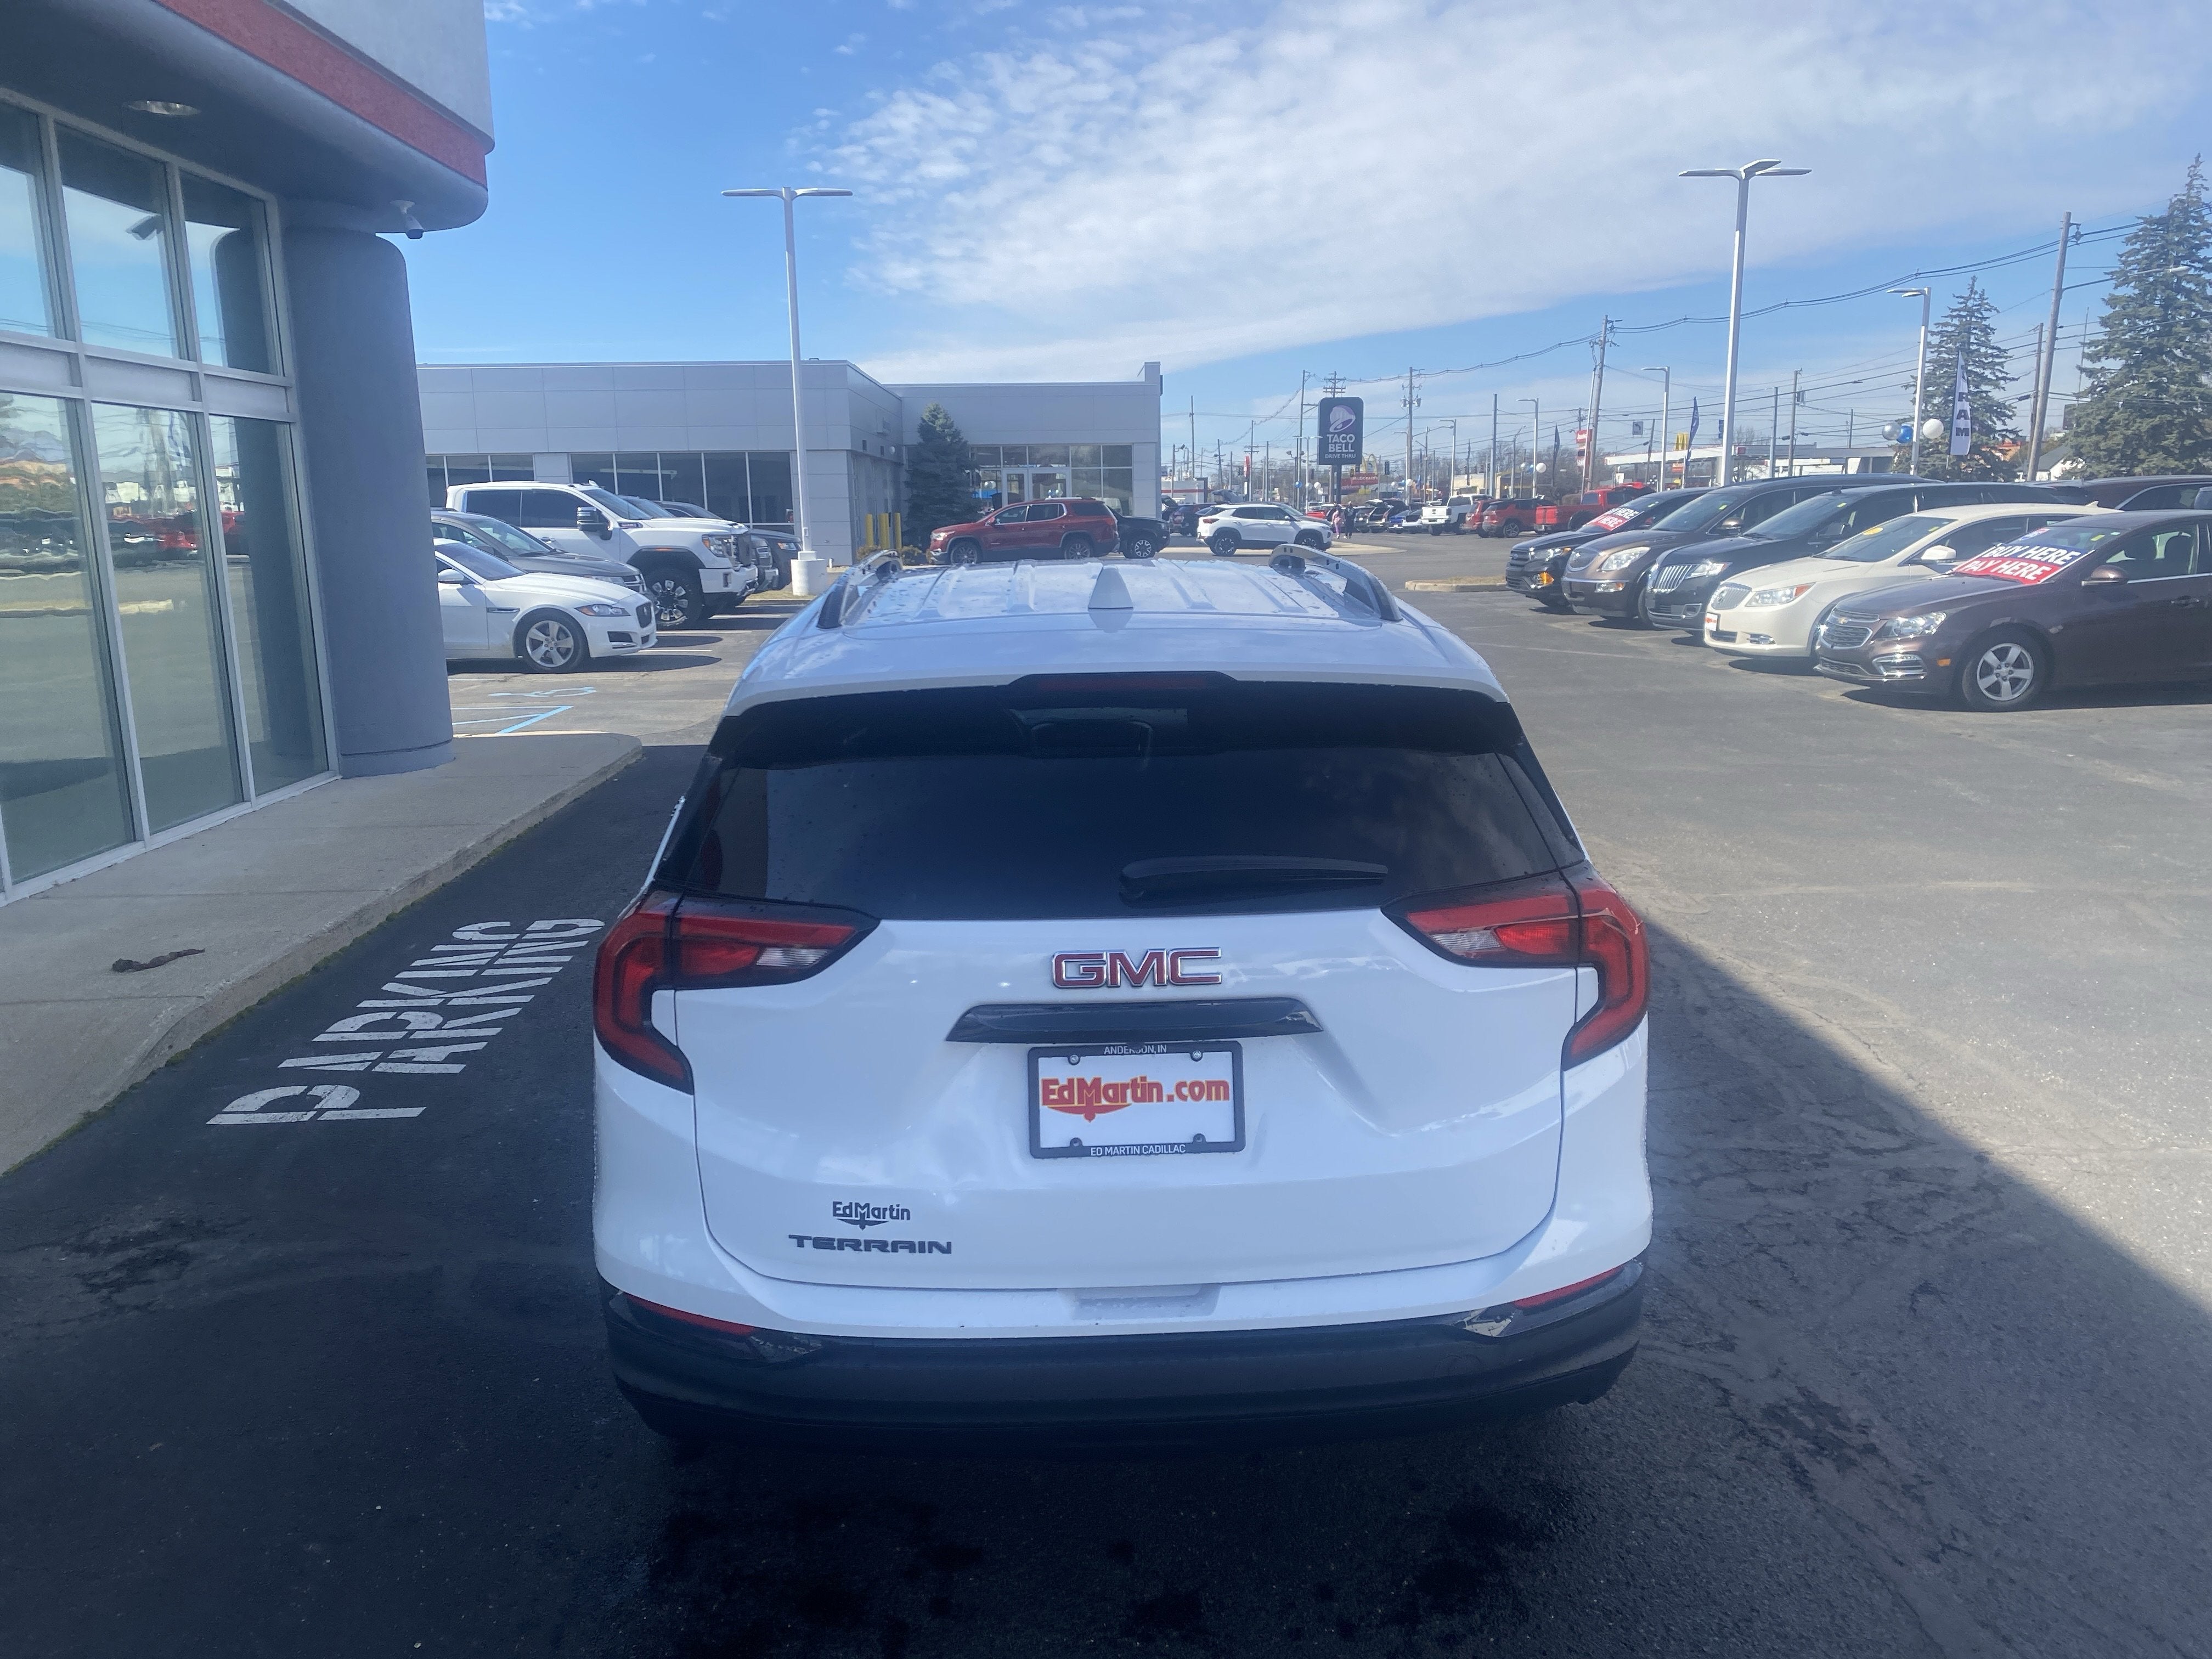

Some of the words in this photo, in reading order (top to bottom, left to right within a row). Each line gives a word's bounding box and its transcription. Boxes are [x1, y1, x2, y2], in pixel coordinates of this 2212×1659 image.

[1955, 392, 1970, 437] RAM
[1327, 434, 1356, 443] TACO
[1328, 443, 1355, 453] BELL
[1597, 516, 1624, 528] HERE
[1615, 507, 1640, 520] HERE
[1982, 545, 2029, 558] BUY
[2024, 545, 2081, 565] HERE
[1962, 559, 2002, 572] PAY
[1990, 560, 2052, 580] HERE
[1052, 947, 1222, 989] GMC
[206, 917, 605, 1126] PARKING
[1090, 1147, 1103, 1156] ED
[1104, 1146, 1140, 1155] MARTIN
[1142, 1144, 1186, 1154] CADILLAC
[788, 1234, 952, 1255] TERRAIN
